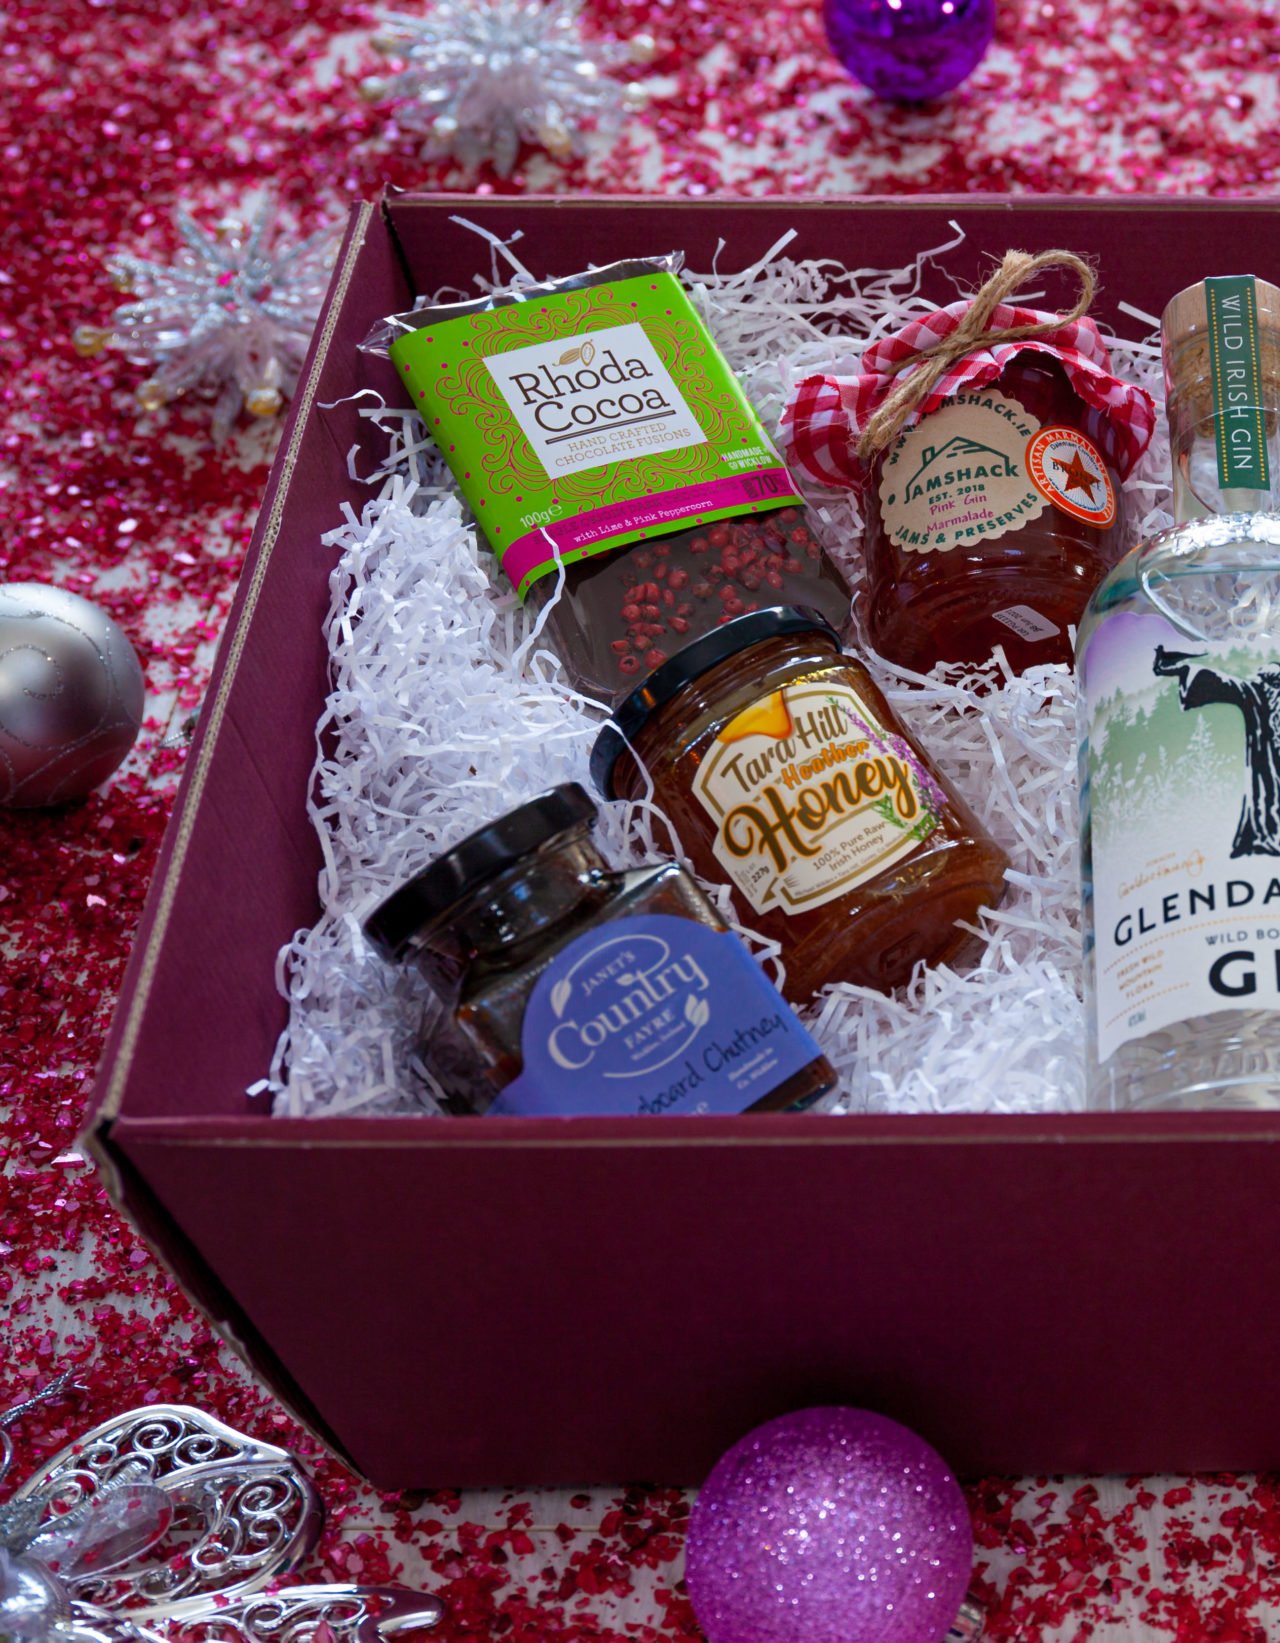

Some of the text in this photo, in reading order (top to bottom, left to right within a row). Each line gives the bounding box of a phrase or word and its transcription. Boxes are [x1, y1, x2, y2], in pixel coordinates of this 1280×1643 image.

[508, 350, 653, 406] Rhoda
[1221, 294, 1253, 470] WILD IRISH GIN
[534, 388, 670, 433] Cocoa
[555, 428, 692, 468] CHOCOLATE FUSIONS
[568, 422, 667, 452] HAND CRAFTED
[1032, 442, 1056, 492] ARTISAN
[929, 484, 986, 505] EST. 2018
[929, 494, 988, 516] Pink Gin
[573, 499, 714, 543] with Lime & Pink Peppercorn
[895, 525, 930, 545] JAMS
[935, 532, 947, 544] &
[955, 492, 1038, 540] PRESERVES
[926, 508, 994, 534] Marmalade
[720, 704, 849, 793] Tara Hill
[781, 739, 870, 791] Heather
[723, 755, 918, 874] Honey
[812, 849, 841, 871] 100%
[839, 834, 864, 853] Pure
[863, 822, 886, 835] Raw
[828, 853, 851, 872] Irish
[850, 833, 885, 857] Honey
[751, 864, 770, 883] 227g
[1205, 929, 1249, 946] WILD
[580, 949, 636, 996] JANET'S
[547, 953, 710, 1070] Country
[623, 1008, 676, 1050] FAYRE
[703, 1013, 789, 1072] Chutney
